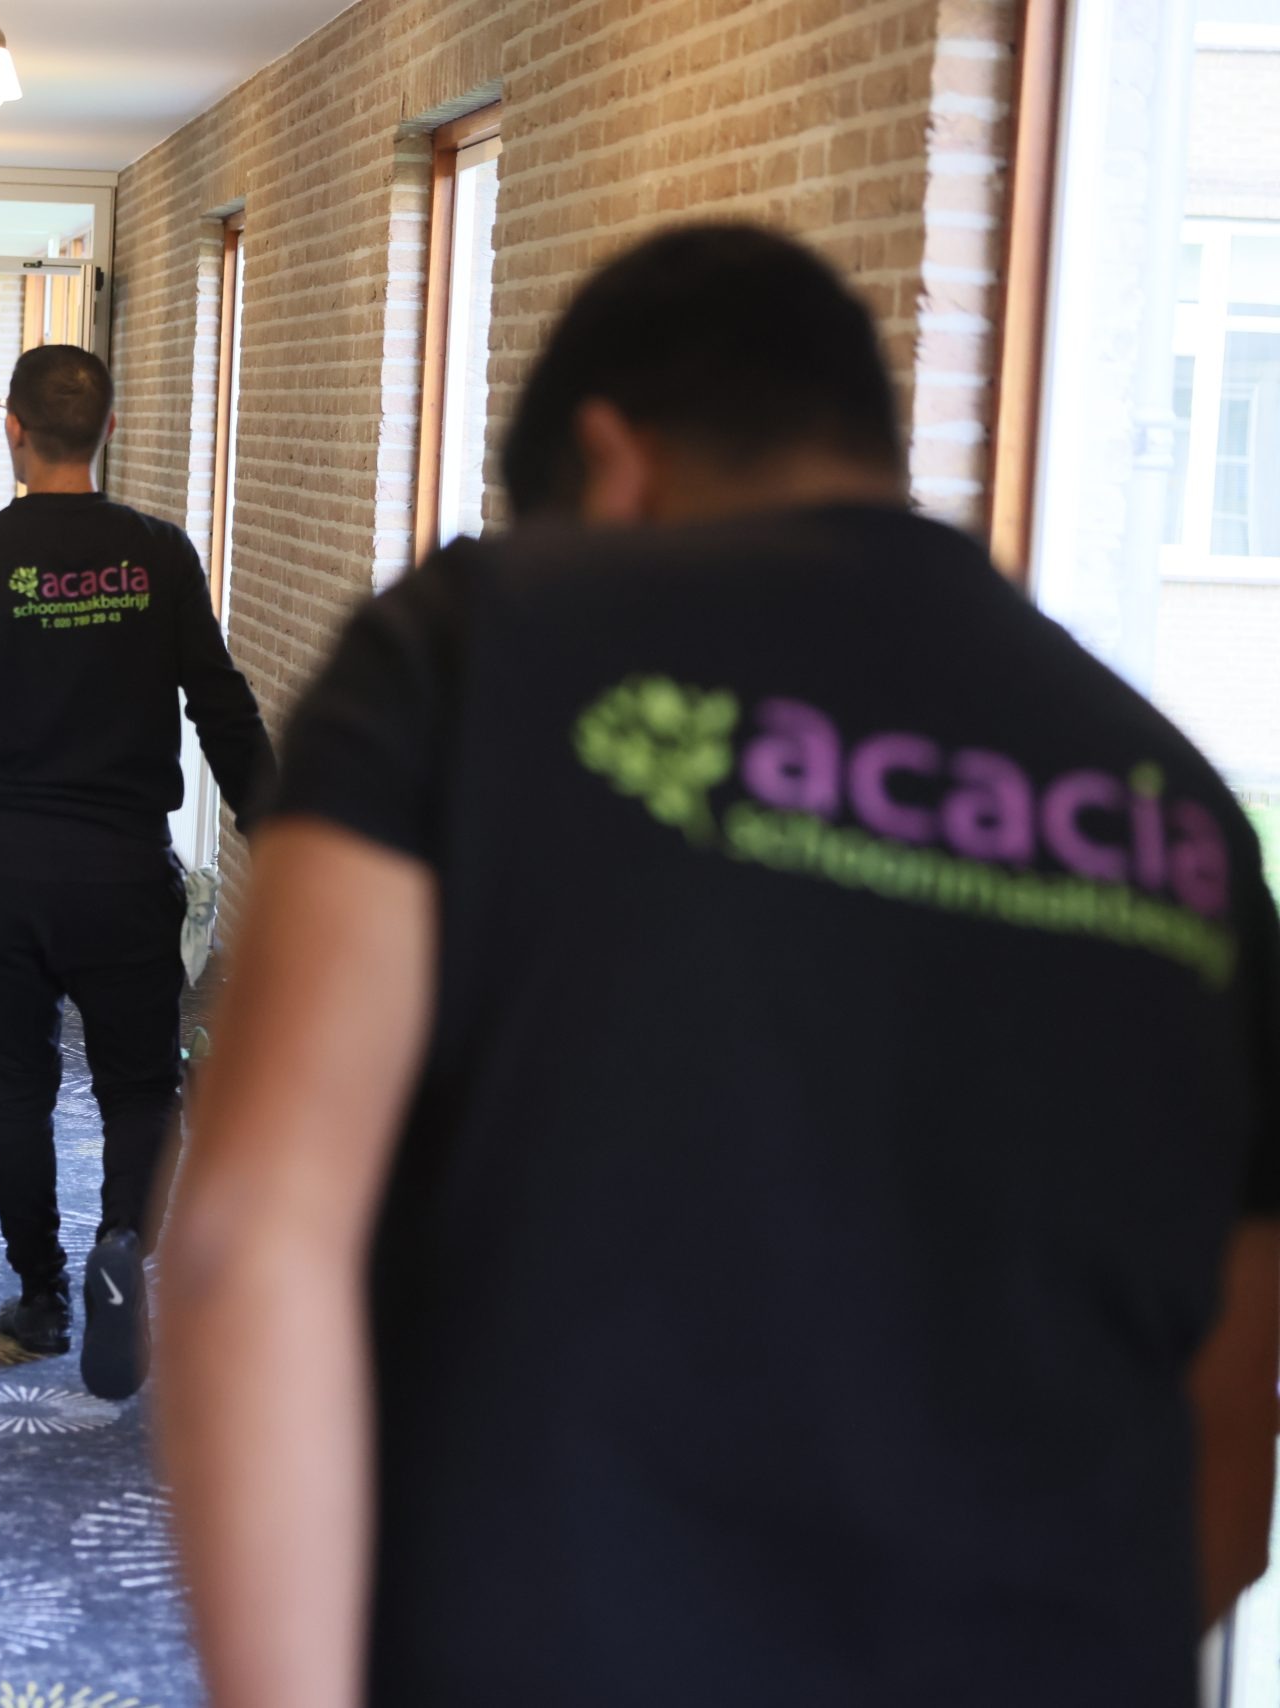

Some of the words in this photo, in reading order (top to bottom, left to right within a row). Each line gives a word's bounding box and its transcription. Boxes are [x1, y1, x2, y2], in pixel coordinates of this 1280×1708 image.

[41, 560, 149, 597] acacia
[13, 593, 151, 618] schoonmaakbedrijf
[741, 696, 1228, 912] acacia
